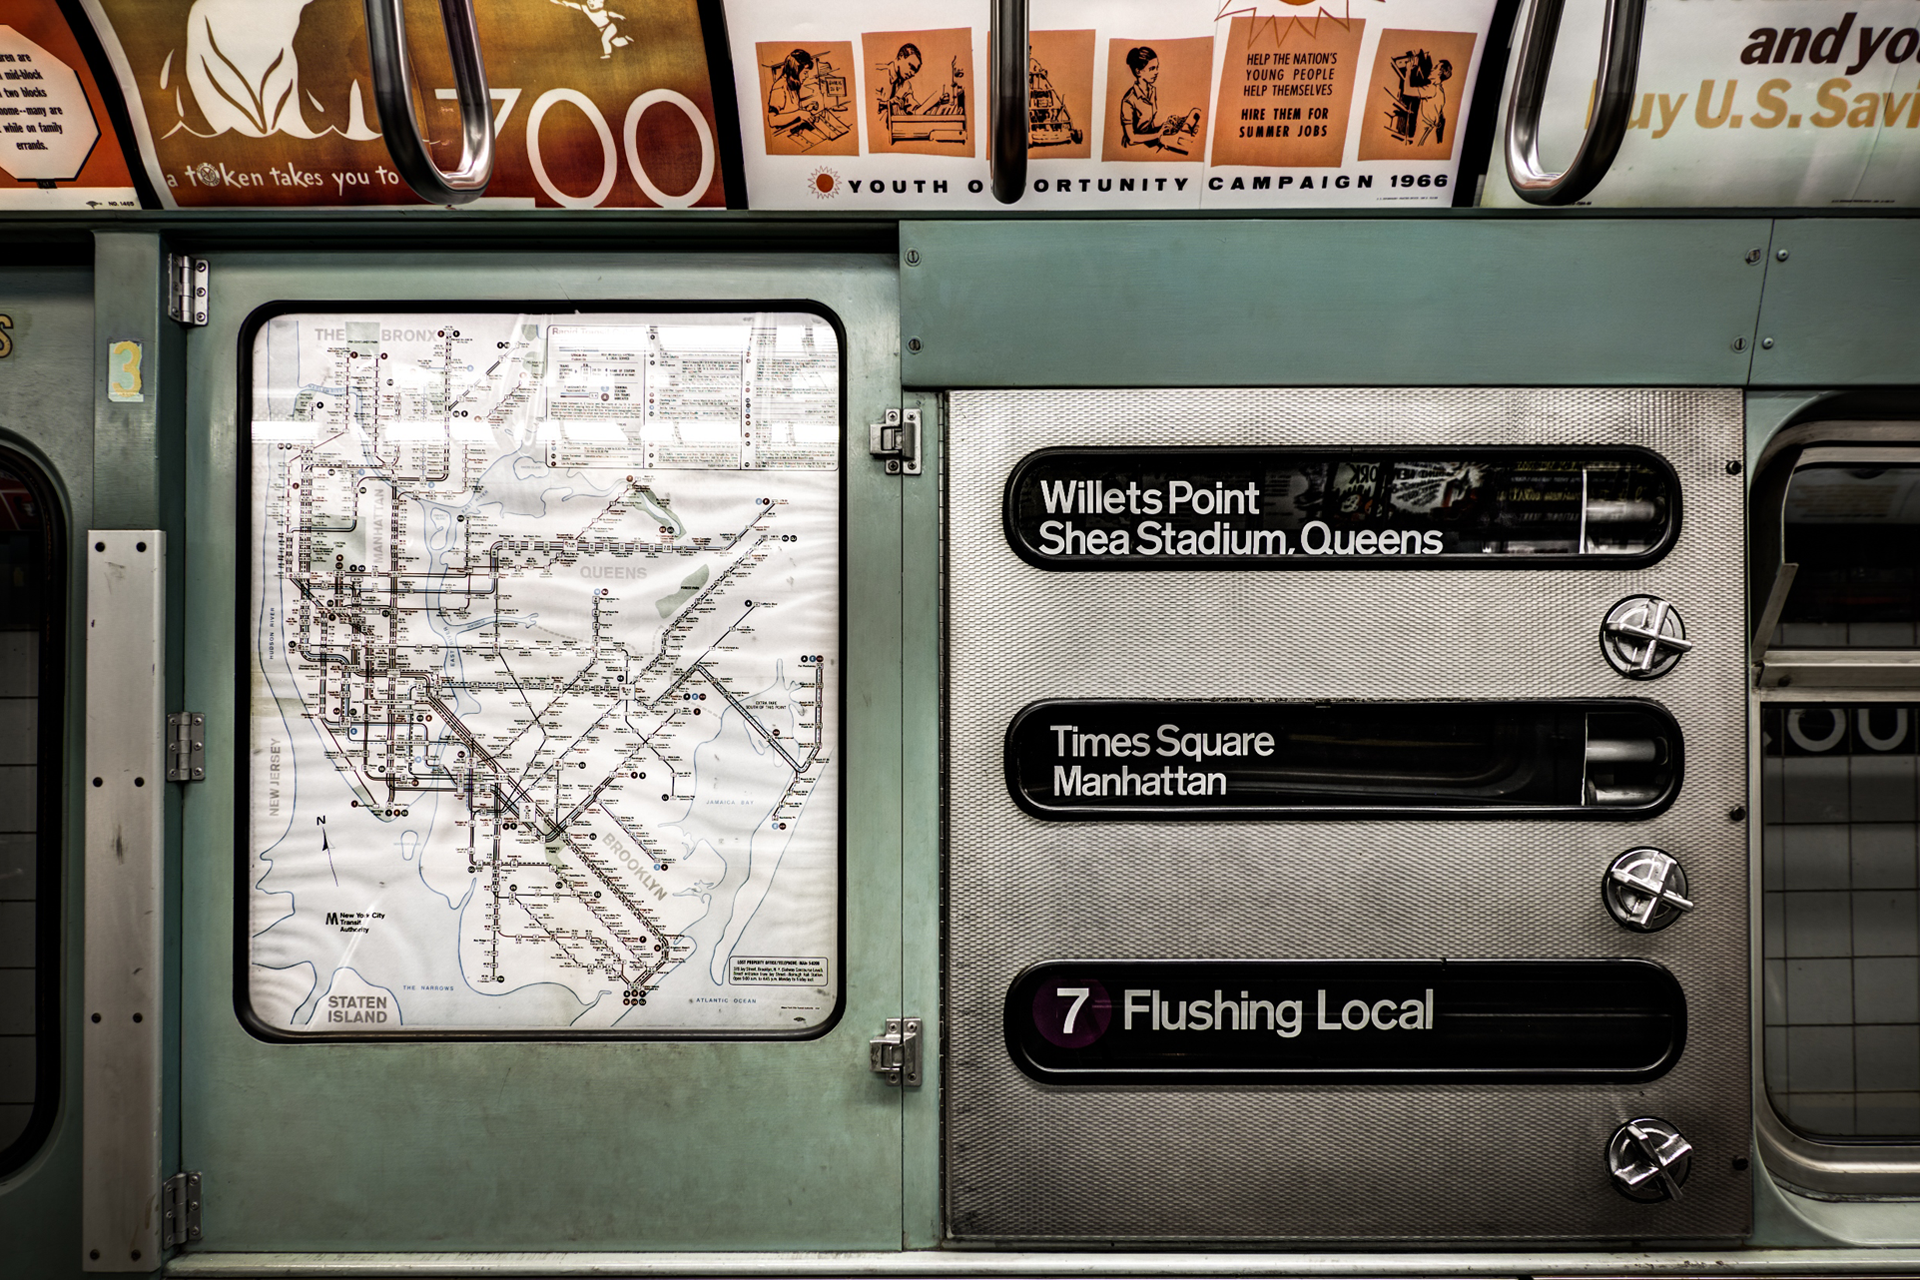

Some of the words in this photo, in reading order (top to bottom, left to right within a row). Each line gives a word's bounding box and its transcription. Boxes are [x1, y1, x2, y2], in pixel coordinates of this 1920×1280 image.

[1740, 12, 1857, 65] and
[1845, 27, 1920, 76] yo
[17, 53, 31, 62] are
[1247, 53, 1270, 65] HELP
[1273, 53, 1291, 65] THE
[1293, 52, 1337, 65] NATION'S
[4, 69, 43, 80] mid-block
[1246, 69, 1284, 81] YOUNG
[1293, 68, 1335, 80] PEOPLE
[3, 88, 19, 98] two
[20, 87, 47, 98] blocks
[1243, 85, 1267, 96] HELP
[1272, 84, 1333, 96] THEMSELVES
[1695, 78, 1801, 129] U.S.
[49, 107, 63, 115] are
[1241, 108, 1265, 120] HIRE
[1273, 108, 1301, 120] THEM
[1308, 108, 1329, 120] FOR
[3, 122, 24, 133] while
[26, 124, 37, 133] on
[38, 122, 63, 134] family
[1239, 125, 1289, 138] SUMMER
[1297, 125, 1327, 137] JOBS
[16, 140, 48, 150] errands.
[166, 173, 178, 187] a
[184, 162, 264, 188] token
[269, 161, 324, 188] takes
[331, 171, 371, 196] you
[375, 165, 399, 185] to
[848, 180, 949, 194] YOUTH
[967, 177, 1189, 194] OORTUNITY
[1207, 175, 1374, 190] CAMPAIGN
[1390, 174, 1449, 188] 1966
[315, 328, 345, 341] THE
[381, 329, 439, 342] BRONX
[111, 340, 142, 398] 3
[1040, 480, 1164, 516] Willets
[1168, 480, 1261, 516] Point
[373, 488, 384, 563] MANHATTAN
[1038, 520, 1131, 556] Shea
[1300, 522, 1445, 556] Queens
[580, 565, 647, 579] QUEENS
[1050, 724, 1151, 759] Times
[1156, 724, 1276, 761] Square
[270, 738, 281, 786] JERSEY
[1053, 764, 1228, 797] Manhattan
[269, 788, 280, 816] NEW
[316, 815, 326, 825] N
[602, 832, 668, 901] BROOKLYN
[328, 995, 387, 1009] STATEN
[328, 1010, 388, 1023] ISLAND
[1055, 987, 1090, 1034] 7
[1123, 988, 1303, 1038] Flushing
[1316, 988, 1435, 1031] Local
